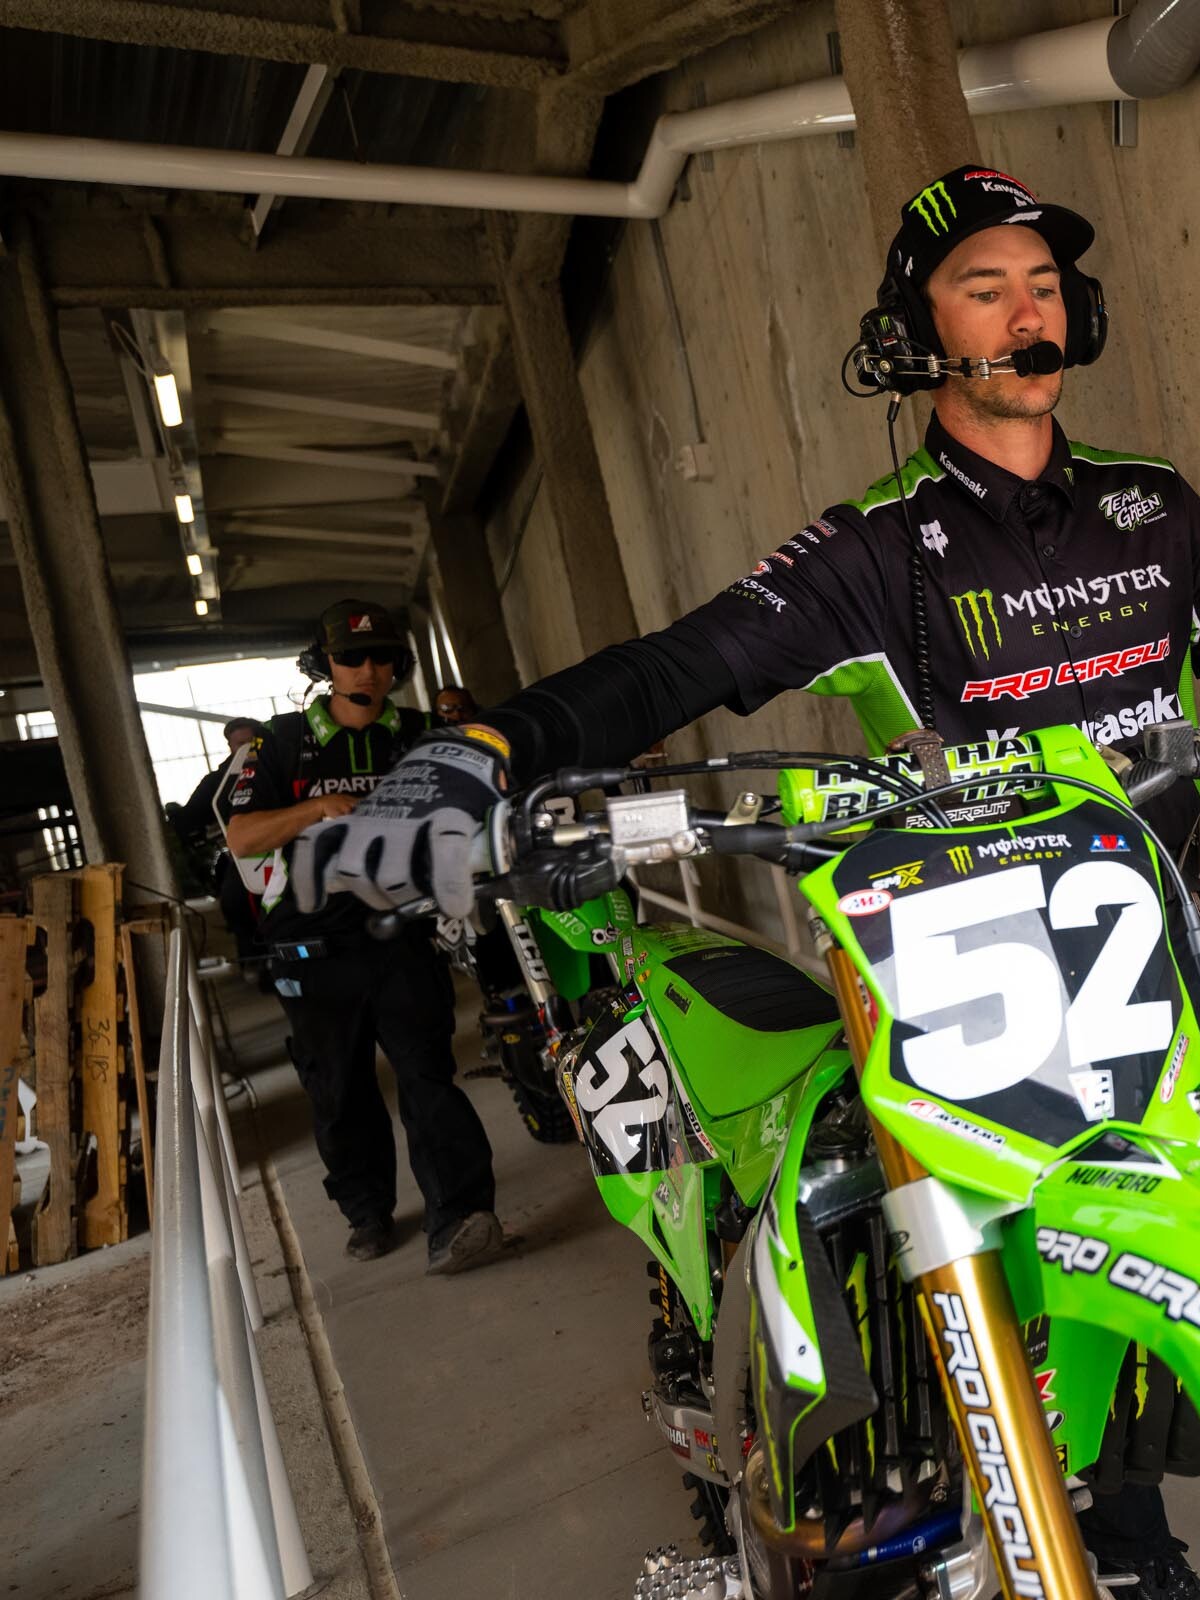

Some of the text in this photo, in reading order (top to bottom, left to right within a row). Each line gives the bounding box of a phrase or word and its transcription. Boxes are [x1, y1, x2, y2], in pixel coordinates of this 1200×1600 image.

[939, 451, 988, 499] Kawasaki
[1100, 488, 1141, 517] TEAM
[1116, 495, 1160, 528] GREEN
[1001, 564, 1171, 618] MONSTER
[1032, 602, 1149, 636] ENERGY
[960, 666, 1053, 702] PRO
[976, 834, 1073, 859] MONSTER
[999, 851, 1064, 866] ENERGY
[871, 865, 924, 891] SMX
[890, 861, 1174, 1101] 52
[576, 1016, 669, 1168] 52
[1066, 1166, 1161, 1194] MUMFORD
[1036, 1226, 1110, 1275] PRO
[933, 1291, 1047, 1600] PRO CIRCUI
